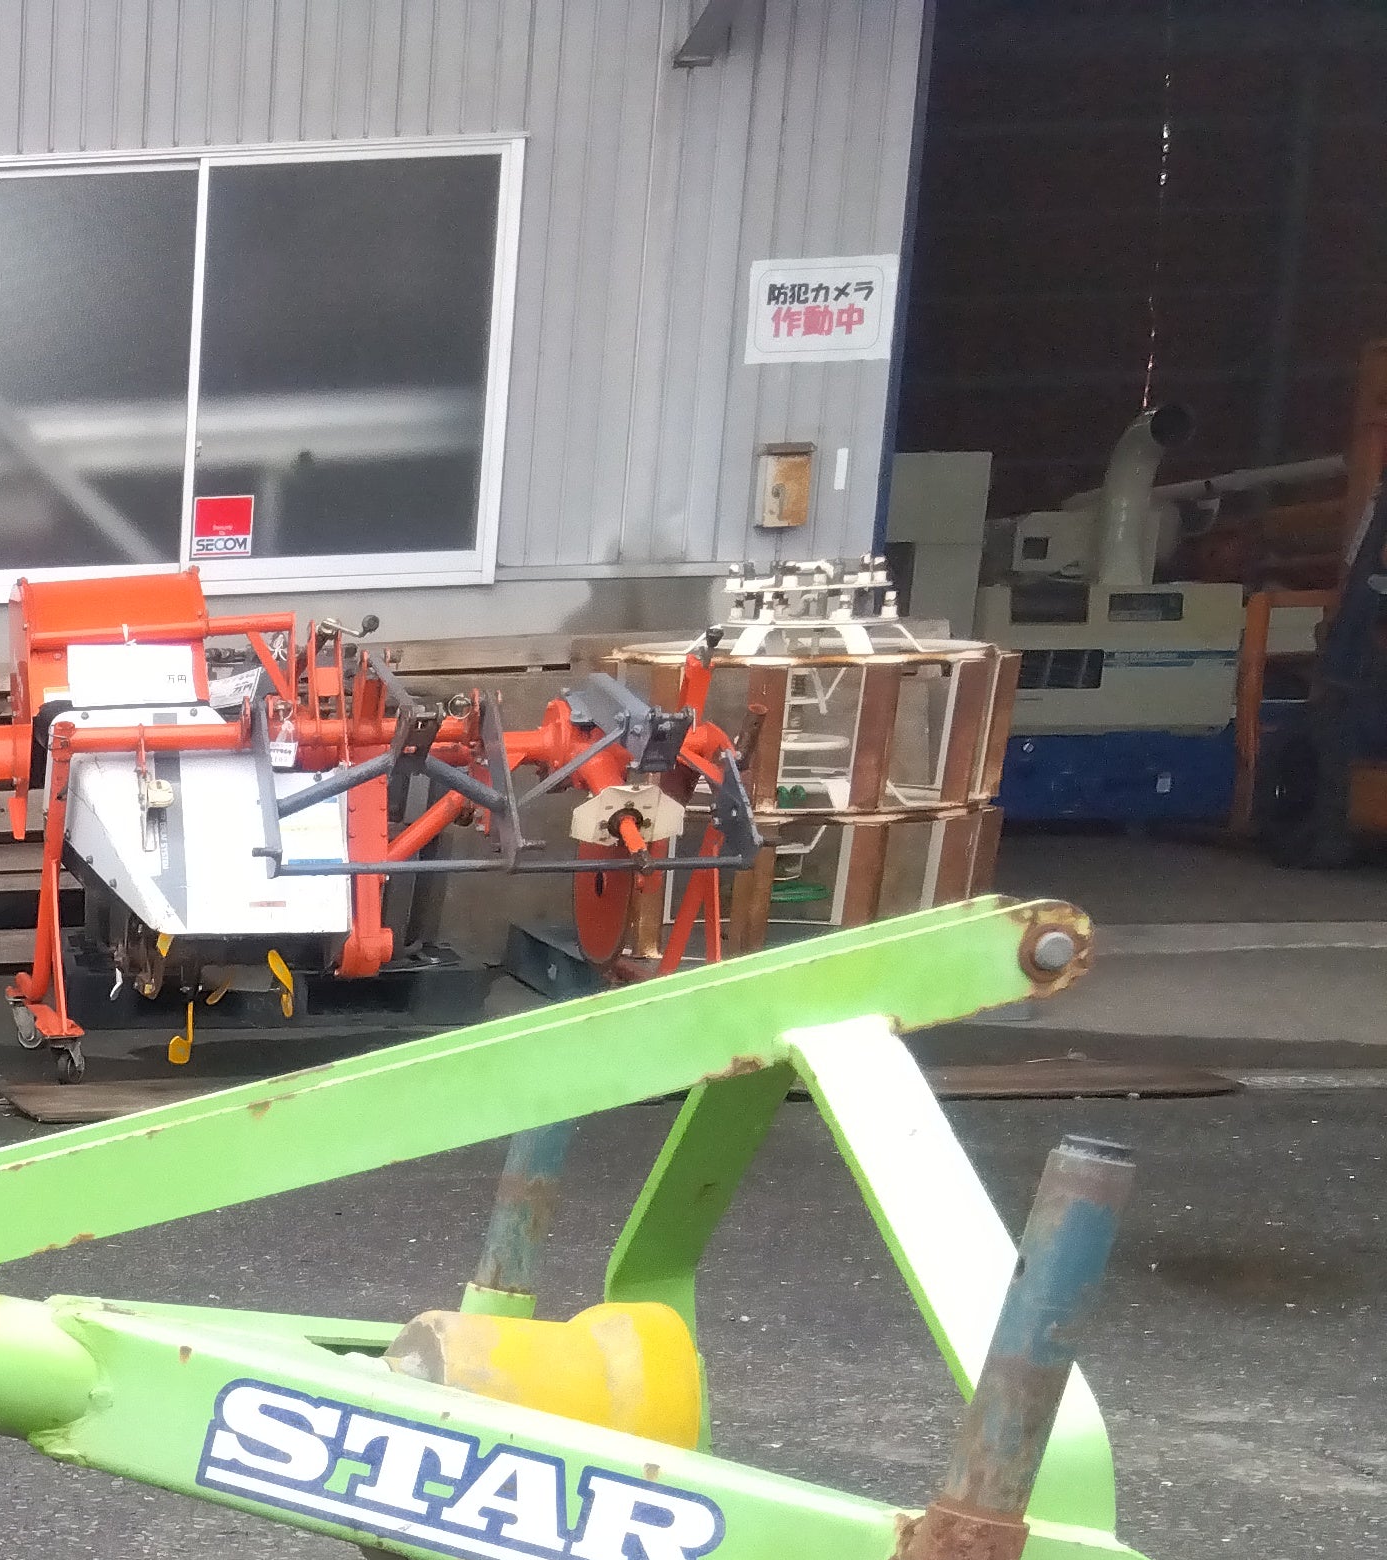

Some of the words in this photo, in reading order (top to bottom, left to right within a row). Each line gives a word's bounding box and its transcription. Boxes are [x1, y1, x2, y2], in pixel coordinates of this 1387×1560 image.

[767, 281, 874, 306] 防犯カメラ
[771, 303, 865, 338] 作動中
[196, 537, 248, 552] SECOM
[167, 674, 187, 685] 万円
